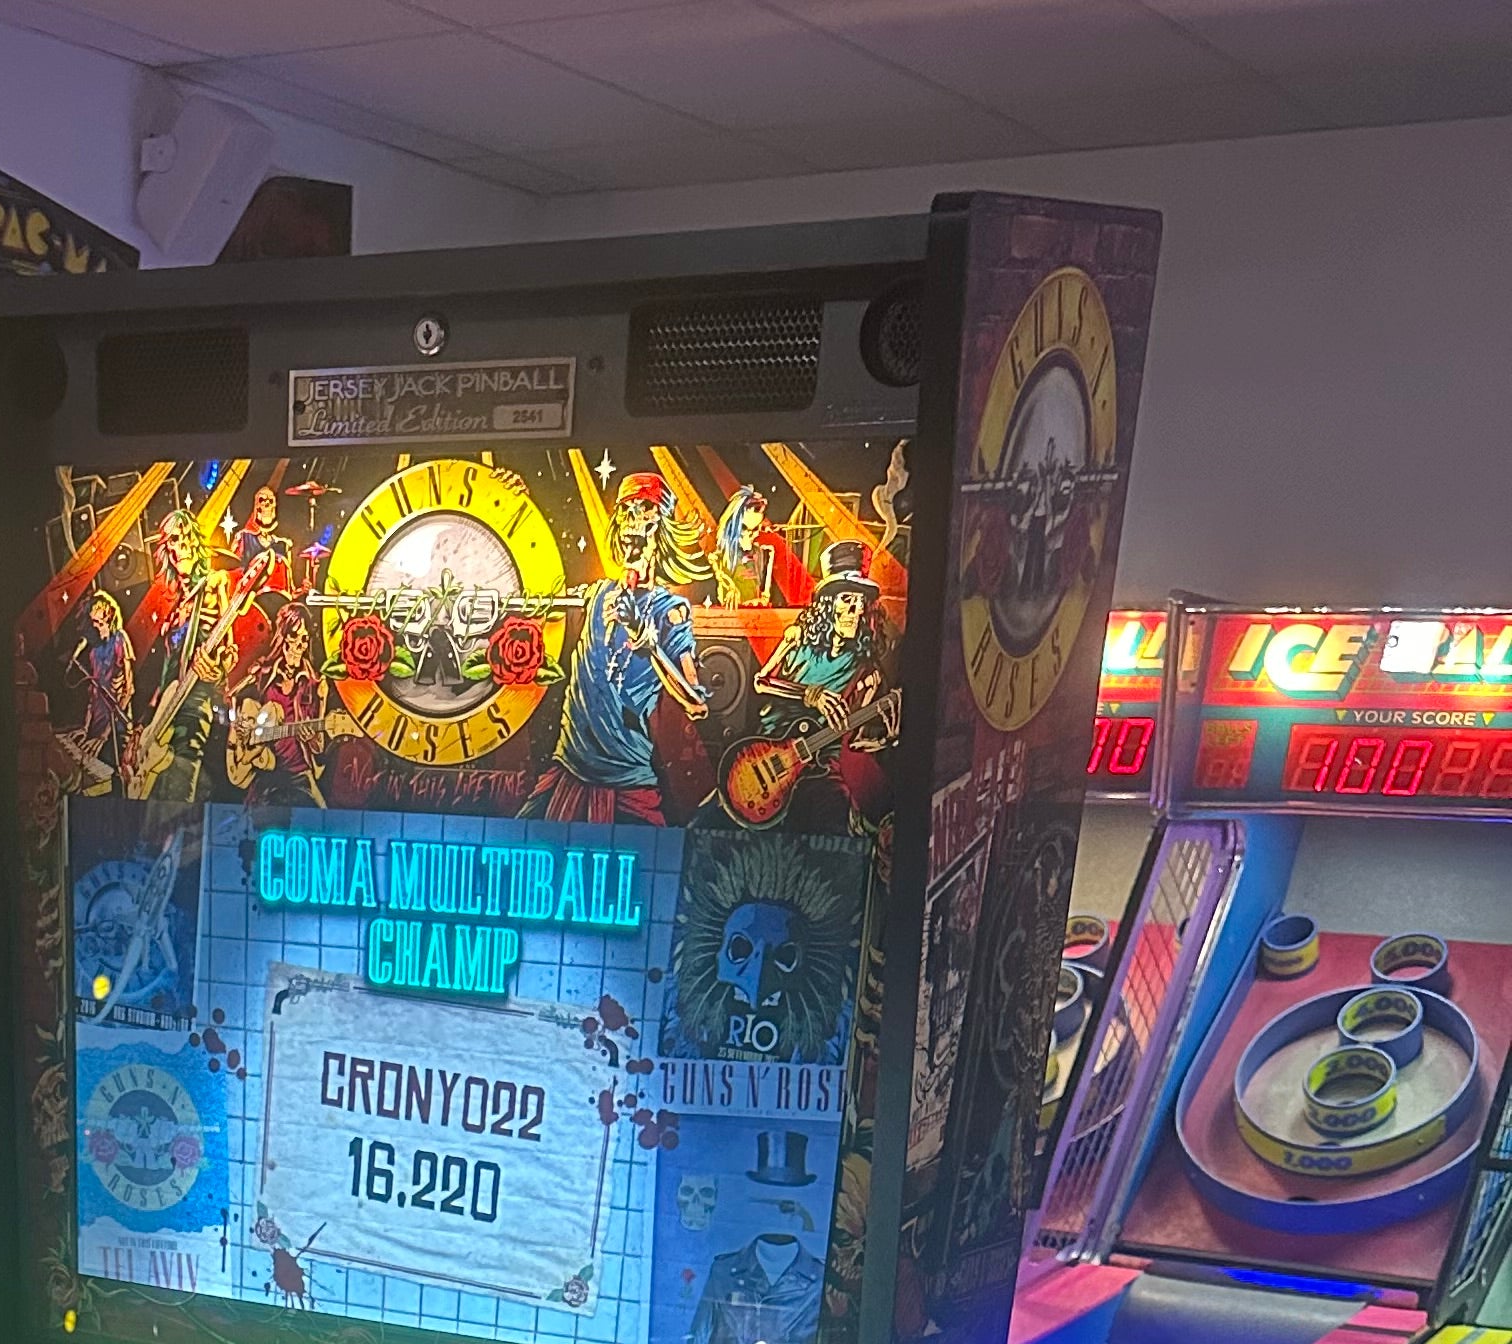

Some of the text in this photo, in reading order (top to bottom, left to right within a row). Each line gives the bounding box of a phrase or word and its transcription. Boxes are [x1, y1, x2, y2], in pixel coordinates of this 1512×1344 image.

[1010, 280, 1088, 391] GUNS
[303, 367, 565, 405] JERSEY JACK PINBALL
[297, 404, 392, 436] Limited
[396, 402, 488, 434] Edition
[360, 463, 479, 541] GUNS
[971, 618, 1061, 720] ROSES
[1228, 622, 1378, 702] ICE
[358, 697, 513, 764] ROSES
[1352, 708, 1477, 727] YOUR SCORE
[256, 827, 643, 928] COMA MULTIBALL
[366, 916, 523, 996] CHAMP
[726, 1013, 779, 1052] RIO
[97, 1065, 157, 1103] GUNS
[662, 1061, 735, 1108] GUNS
[108, 1171, 185, 1208] ROSES
[348, 1135, 503, 1225] 16.220
[147, 1250, 201, 1293] AVIV
